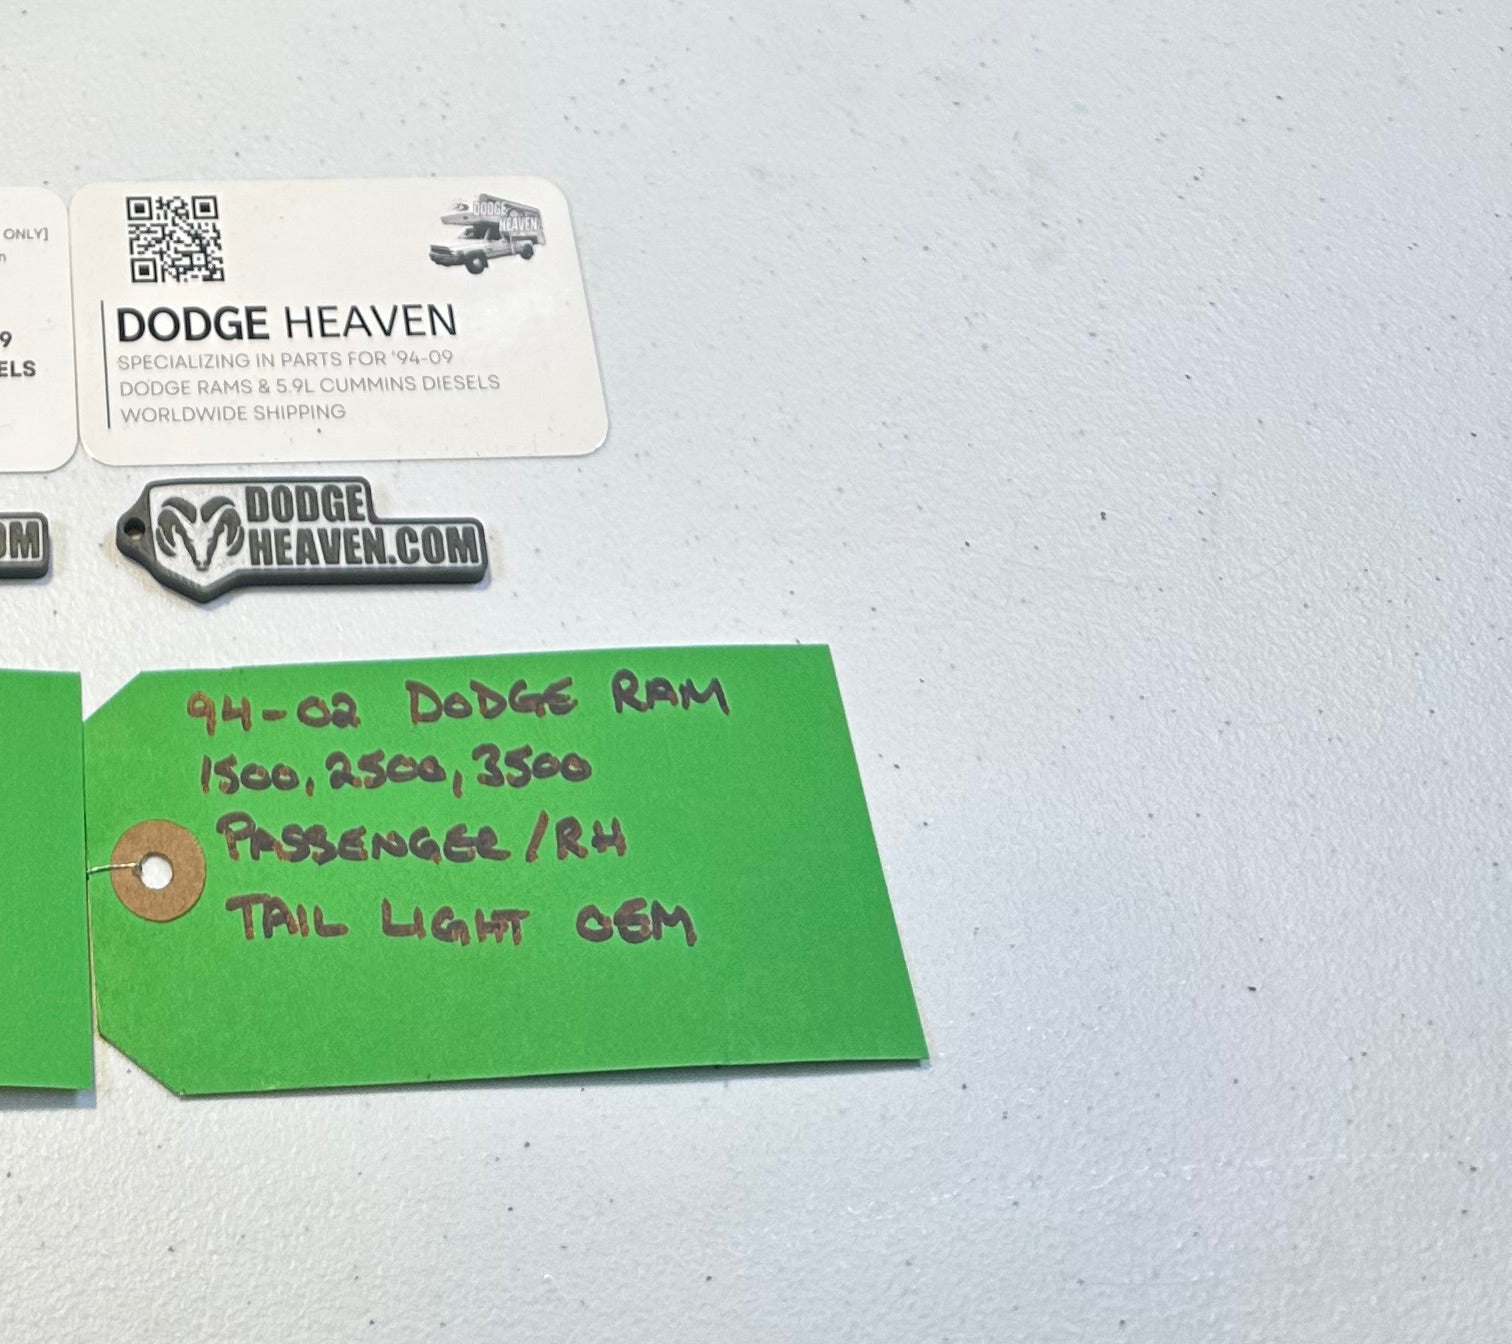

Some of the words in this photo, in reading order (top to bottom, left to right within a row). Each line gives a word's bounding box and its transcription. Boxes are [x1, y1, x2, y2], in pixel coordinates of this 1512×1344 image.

[473, 201, 507, 216] DODGE
[3, 227, 49, 242] ONLY]
[499, 216, 538, 231] HEAVEN
[116, 305, 271, 343] DODGE
[285, 302, 458, 341] HEAVEN
[117, 352, 250, 371] SPECIALIZING
[256, 351, 276, 369] IN
[280, 350, 343, 368] PARTS
[348, 349, 386, 367] FOR
[120, 378, 191, 397] DODGE
[197, 377, 253, 395] RAMS
[258, 377, 271, 394] &
[276, 376, 316, 394] 5.9L
[320, 375, 417, 393] CUMMINS
[422, 373, 501, 391] DIESELS
[120, 405, 248, 424] WORLDWIDE
[253, 403, 346, 421] SHIPPING
[245, 483, 366, 523] DODGE
[245, 524, 480, 567] HEAVEN.COM
[186, 689, 360, 738] 94-02
[404, 676, 581, 728] DODGE
[611, 668, 732, 717] RAM
[226, 892, 350, 942] TAIL
[382, 898, 531, 949] LIGHT
[576, 896, 698, 947] OEM
